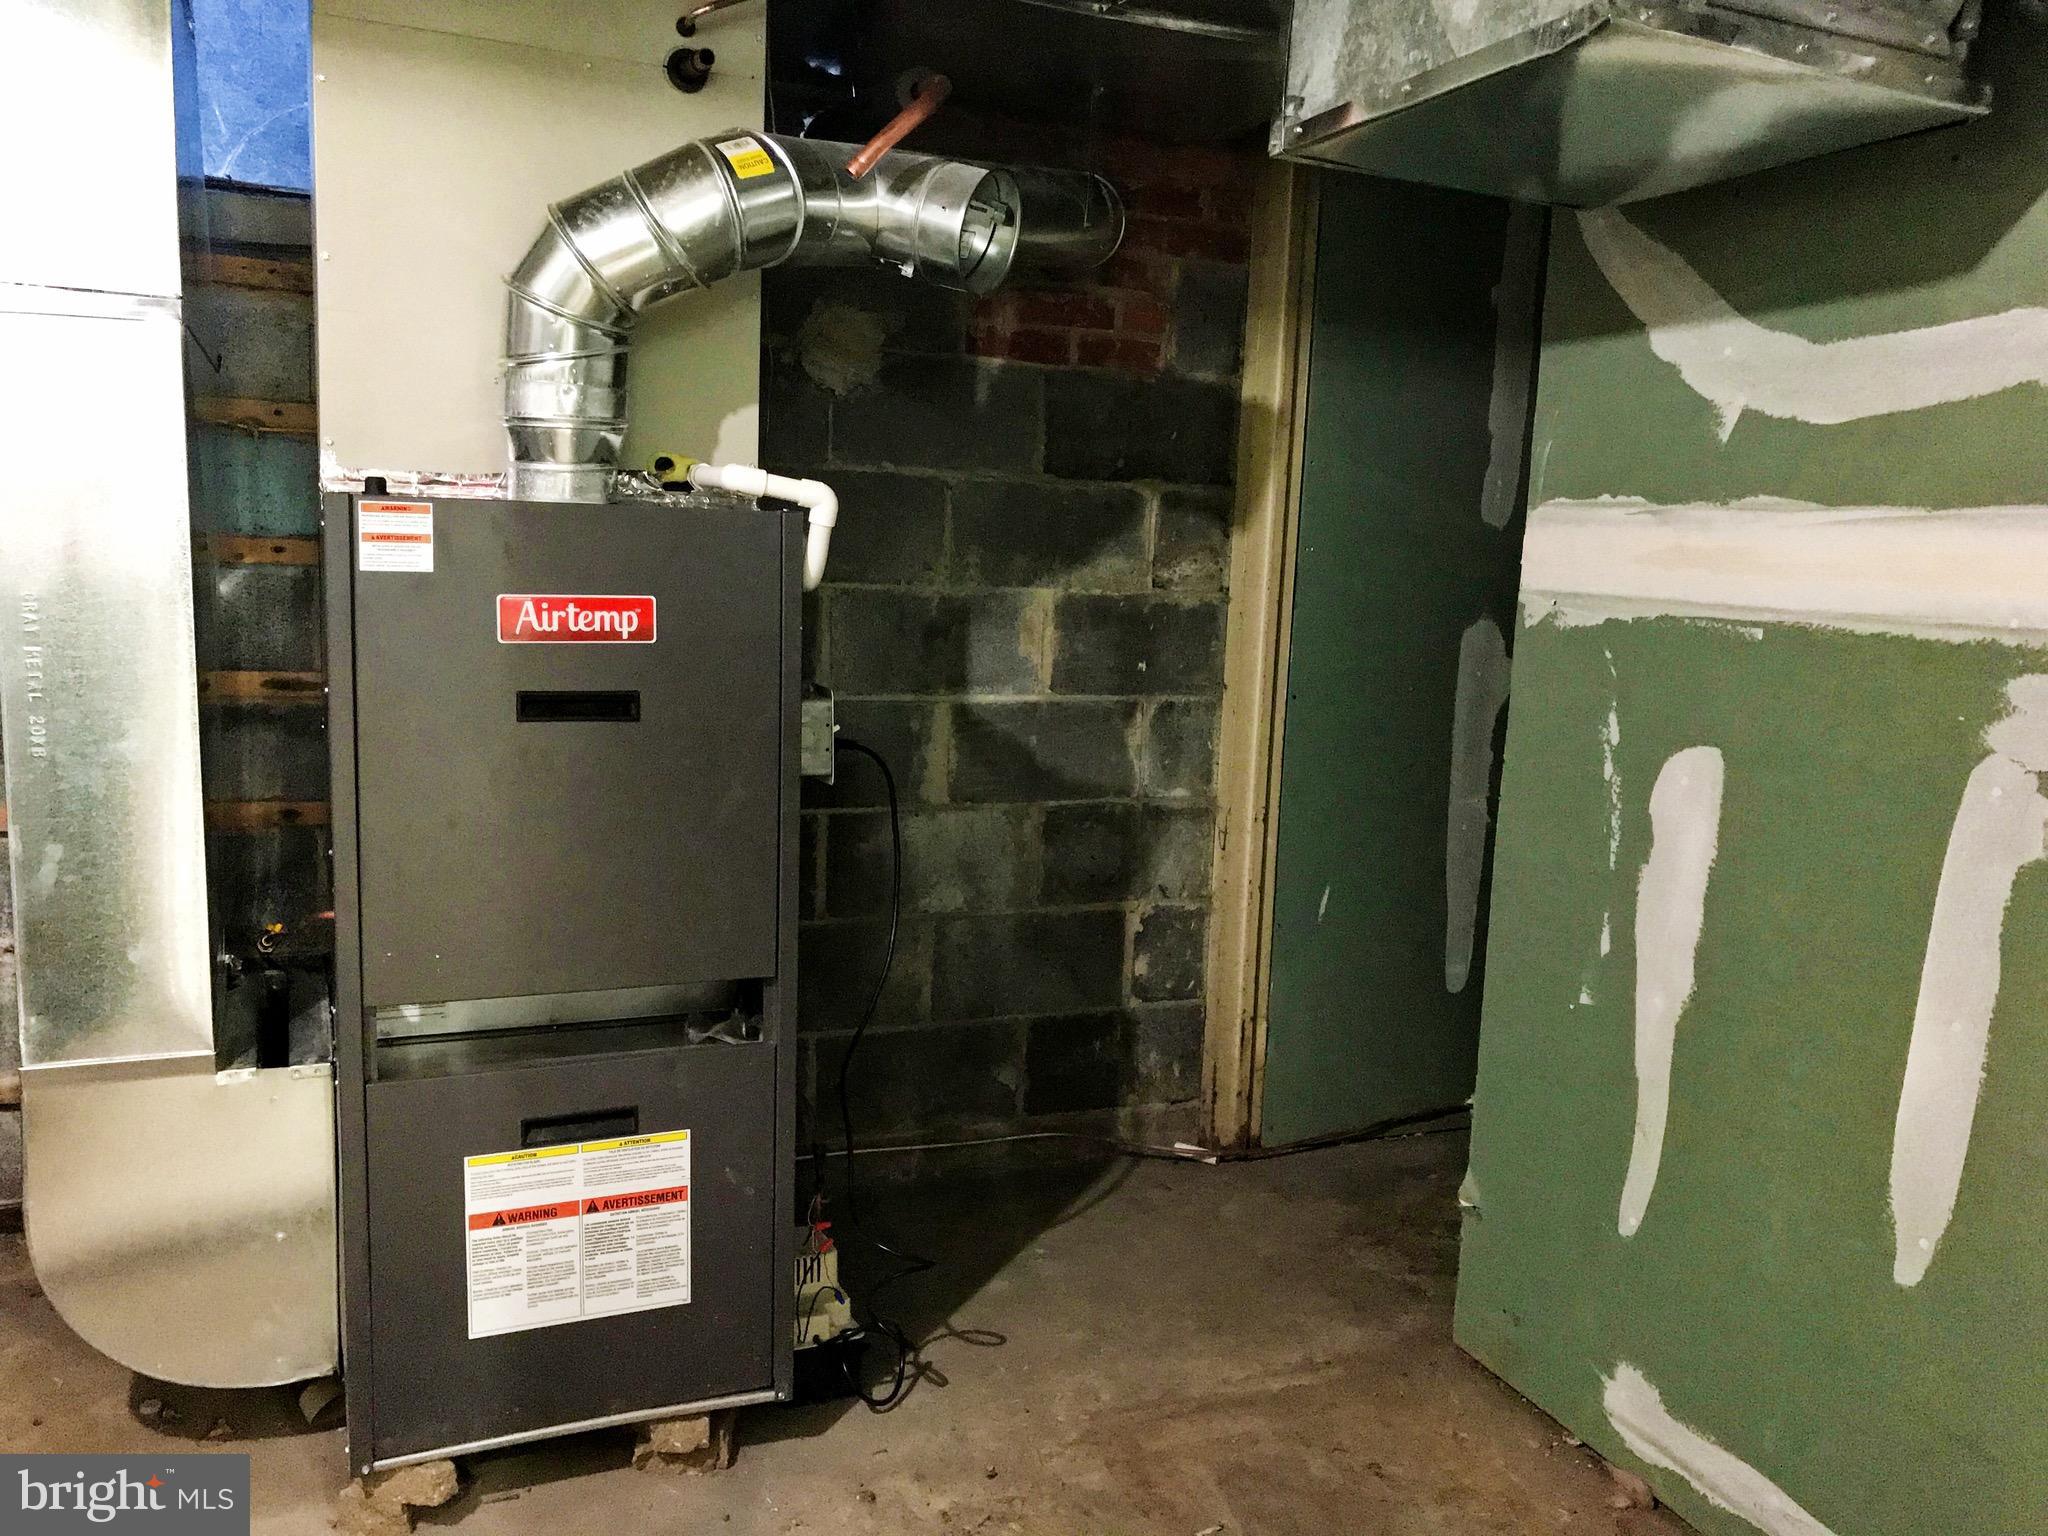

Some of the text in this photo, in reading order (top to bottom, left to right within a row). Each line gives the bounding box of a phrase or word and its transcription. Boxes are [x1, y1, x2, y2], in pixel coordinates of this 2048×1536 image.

[515, 600, 639, 639] Airtemp
[603, 1190, 684, 1210] AVERTISSEMENT
[508, 1207, 558, 1224] WARNING
